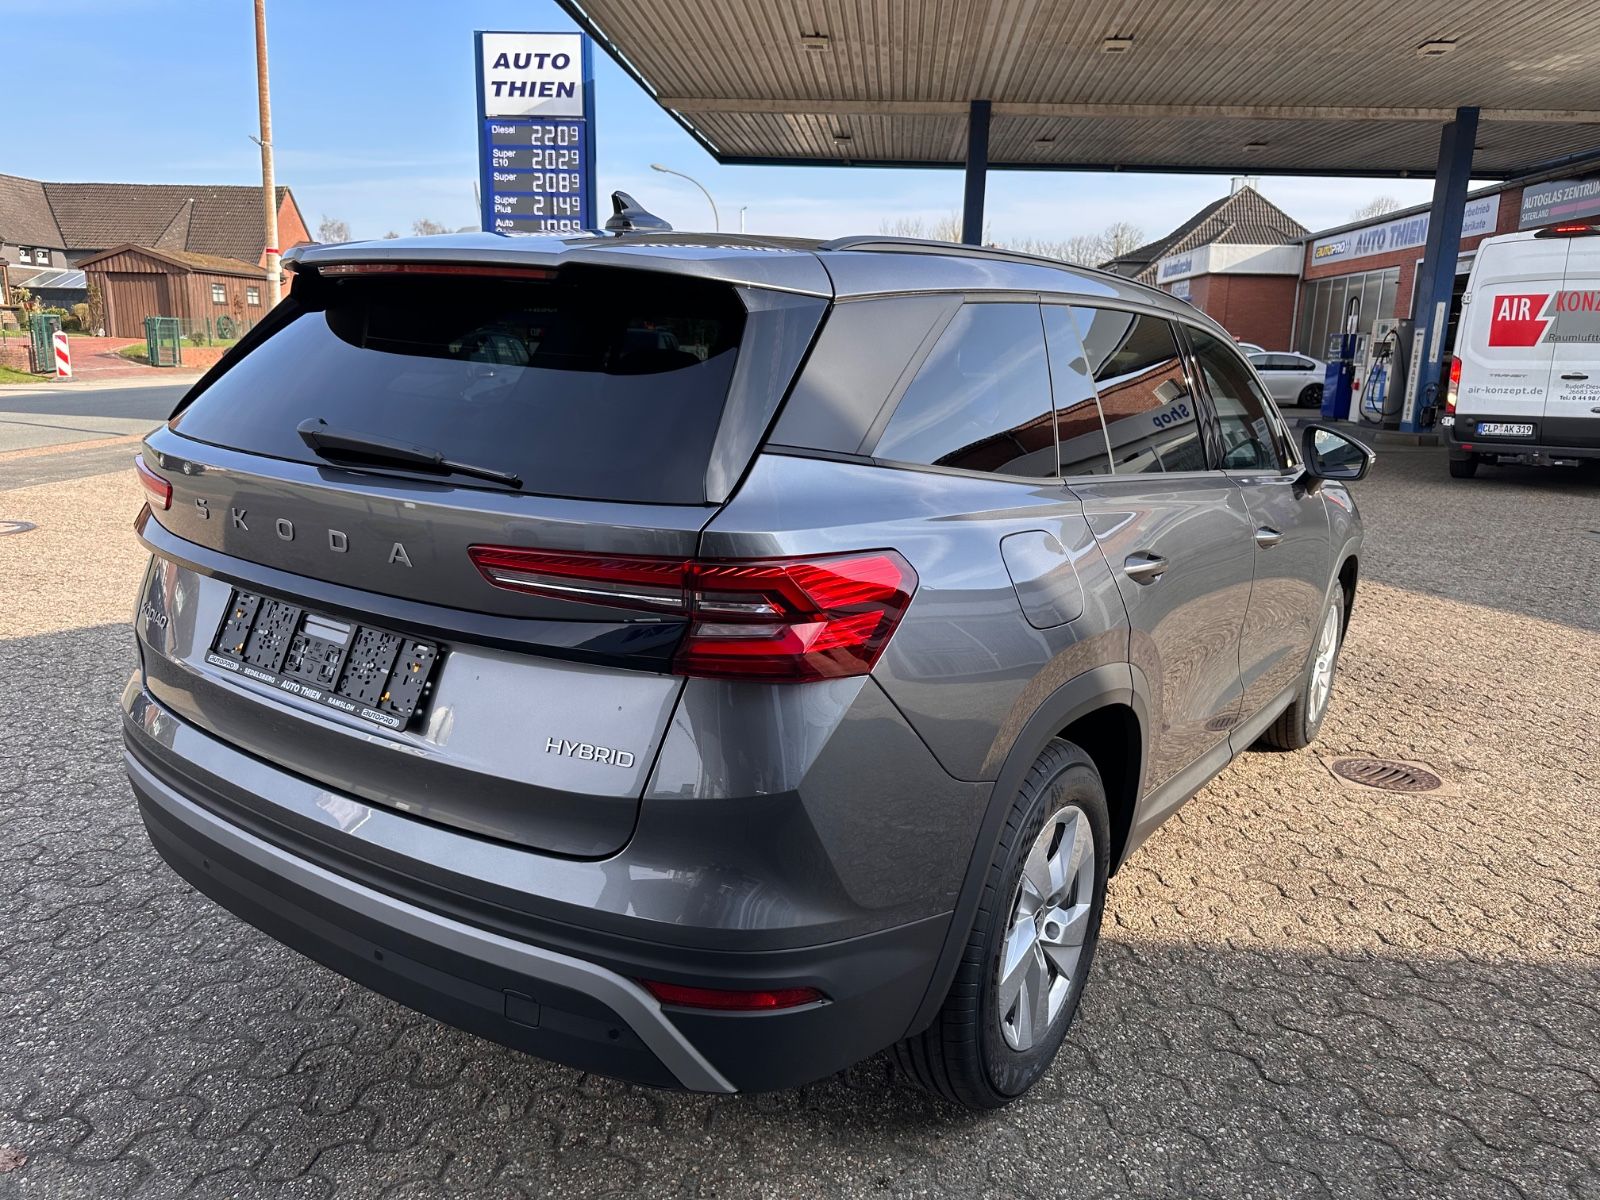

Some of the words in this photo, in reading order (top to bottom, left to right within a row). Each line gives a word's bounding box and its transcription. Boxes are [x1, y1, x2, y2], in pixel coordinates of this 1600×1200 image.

[492, 53, 570, 70] AUTO
[491, 81, 575, 98] THIEN
[491, 125, 516, 134] Diesel
[492, 149, 516, 158] Super
[492, 159, 509, 167] E10
[493, 172, 517, 182] Super
[494, 196, 517, 206] Super
[1523, 189, 1563, 210] AUTOGLAS
[494, 204, 512, 213] Plus
[1522, 209, 1550, 222] SATERLAND
[495, 218, 514, 227] Auto
[1462, 219, 1486, 232] brikate
[1354, 227, 1386, 255] AUTO
[1389, 217, 1428, 249] THIEN
[1497, 298, 1531, 321] AIR
[1548, 333, 1600, 343] Raumluftt
[1468, 386, 1543, 396] air-konzept.de
[1515, 424, 1532, 434] 319
[195, 498, 413, 568] SKODA
[243, 667, 275, 684] SEDELSBERG
[280, 680, 300, 693] AUTO
[300, 685, 322, 700] THIEN
[327, 697, 355, 712] RAMSLOH
[545, 737, 635, 768] HYBRID
